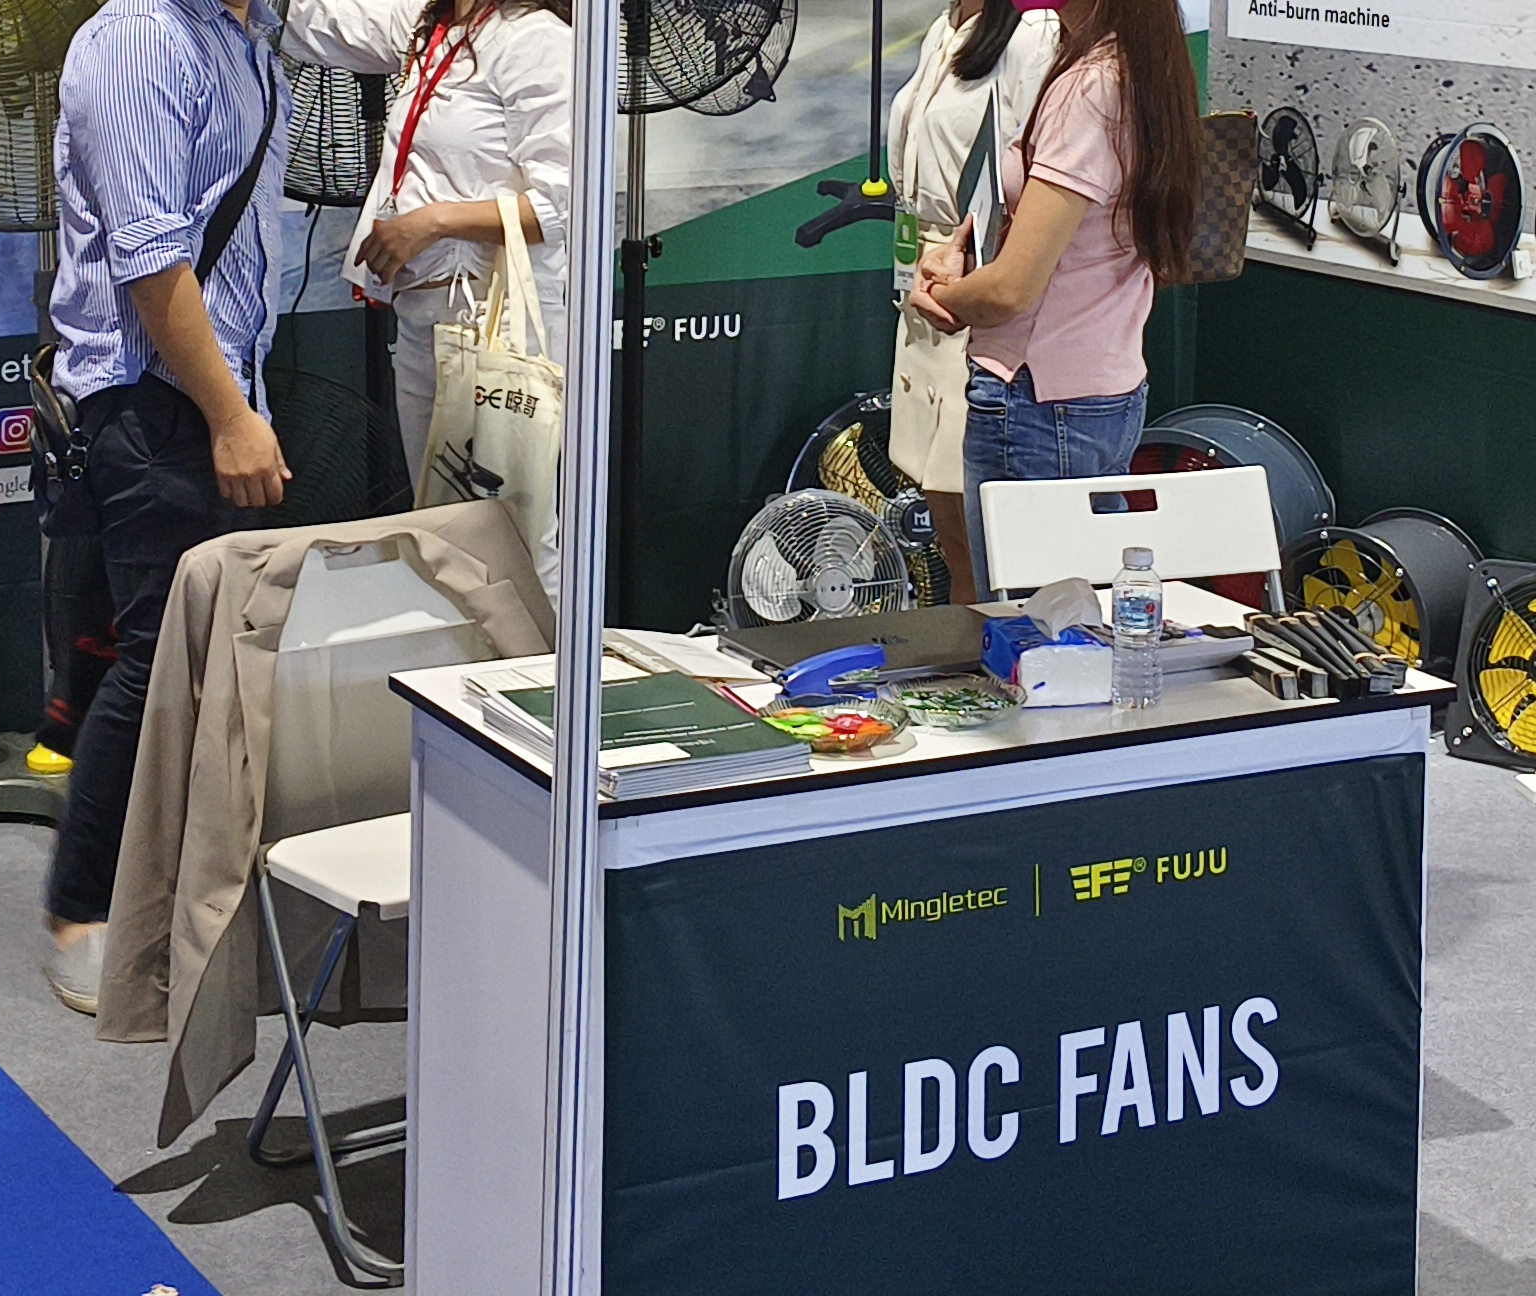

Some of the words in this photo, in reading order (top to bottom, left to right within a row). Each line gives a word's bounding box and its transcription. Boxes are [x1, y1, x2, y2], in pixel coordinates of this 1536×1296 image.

[1324, 6, 1391, 29] machine
[674, 314, 742, 341] FUJU
[881, 883, 1009, 926] Mingletec
[1156, 847, 1228, 884] FUJU
[777, 1044, 1021, 1201] BLDC
[1058, 995, 1280, 1145] FANS
